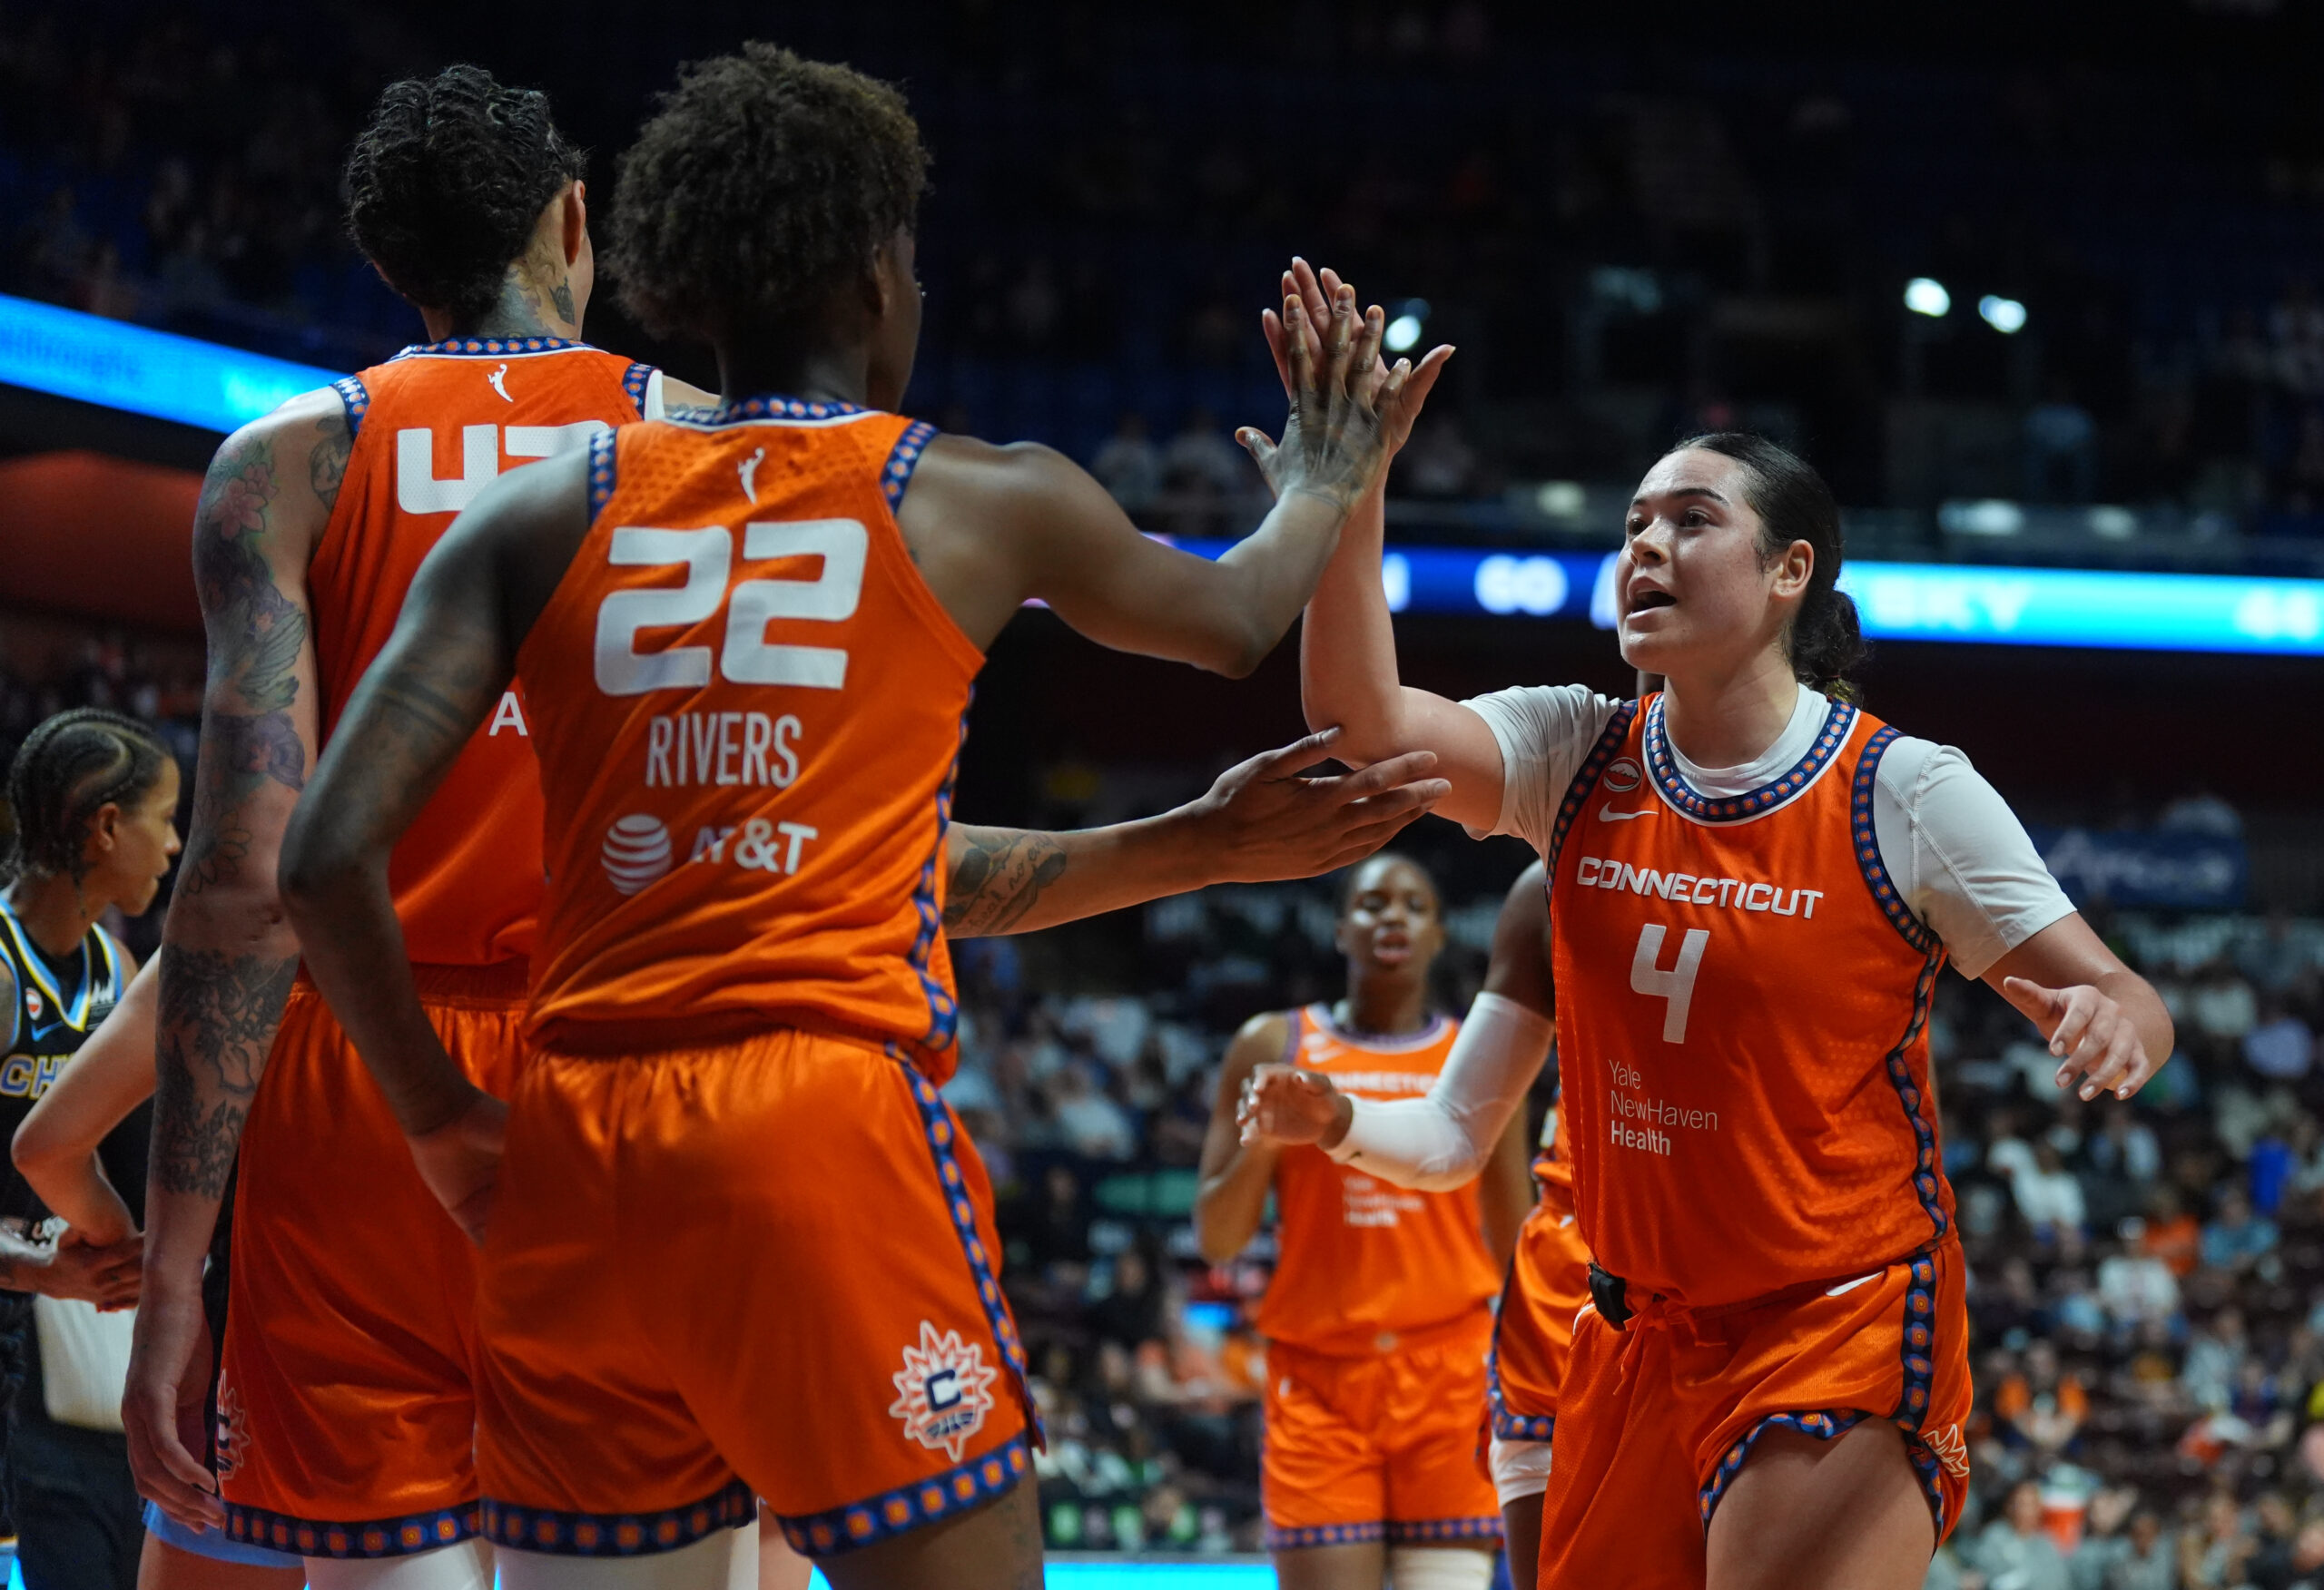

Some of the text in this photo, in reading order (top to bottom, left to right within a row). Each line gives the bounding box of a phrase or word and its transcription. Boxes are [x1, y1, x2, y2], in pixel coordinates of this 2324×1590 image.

[595, 518, 869, 697] 22
[645, 712, 803, 789] RIVERS
[688, 817, 819, 876] AT&T
[1576, 856, 1823, 919] CONNECTICUT
[1630, 922, 1710, 1045] 4
[0, 1053, 76, 1100] CH
[1609, 1059, 1641, 1089] Yale
[1610, 1089, 1718, 1132] NewHaven
[1610, 1120, 1670, 1156] Health
